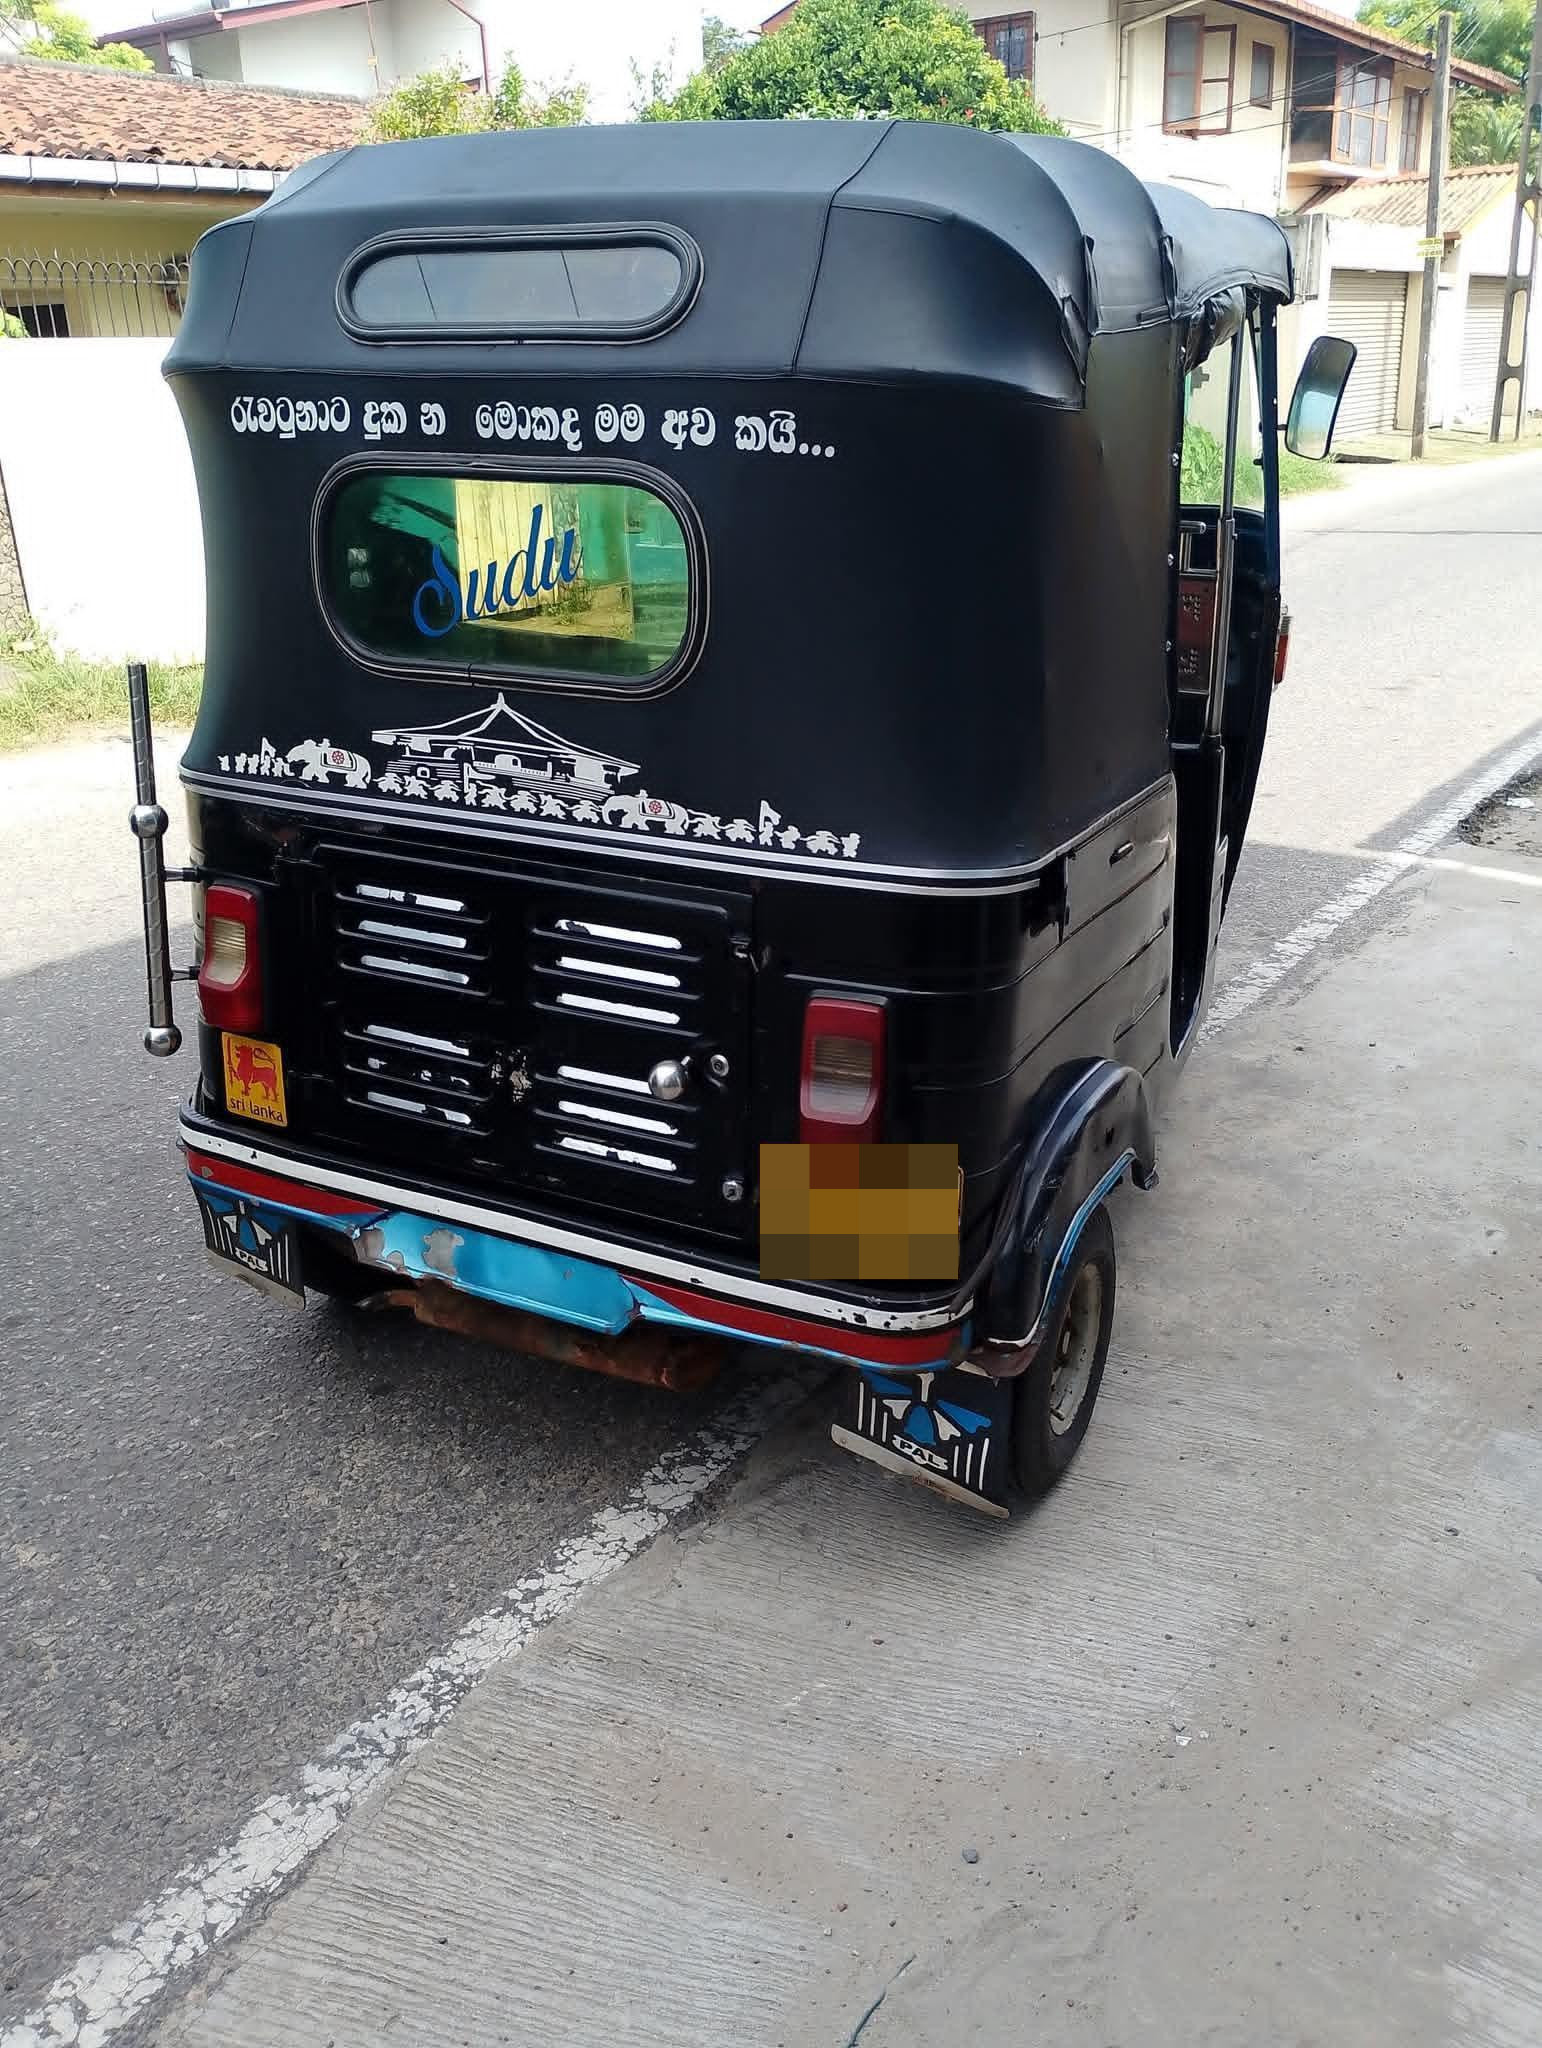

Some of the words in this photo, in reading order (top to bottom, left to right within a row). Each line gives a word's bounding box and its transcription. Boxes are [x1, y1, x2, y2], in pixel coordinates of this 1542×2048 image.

[231, 396, 351, 438] රැවටුනාට
[363, 401, 408, 441] දුක
[476, 400, 583, 452] මොකද
[594, 403, 647, 444] මම
[413, 503, 584, 638] Sudu
[230, 1096, 246, 1111] sri
[249, 1100, 284, 1122] lanka
[899, 1439, 941, 1467] PAL
